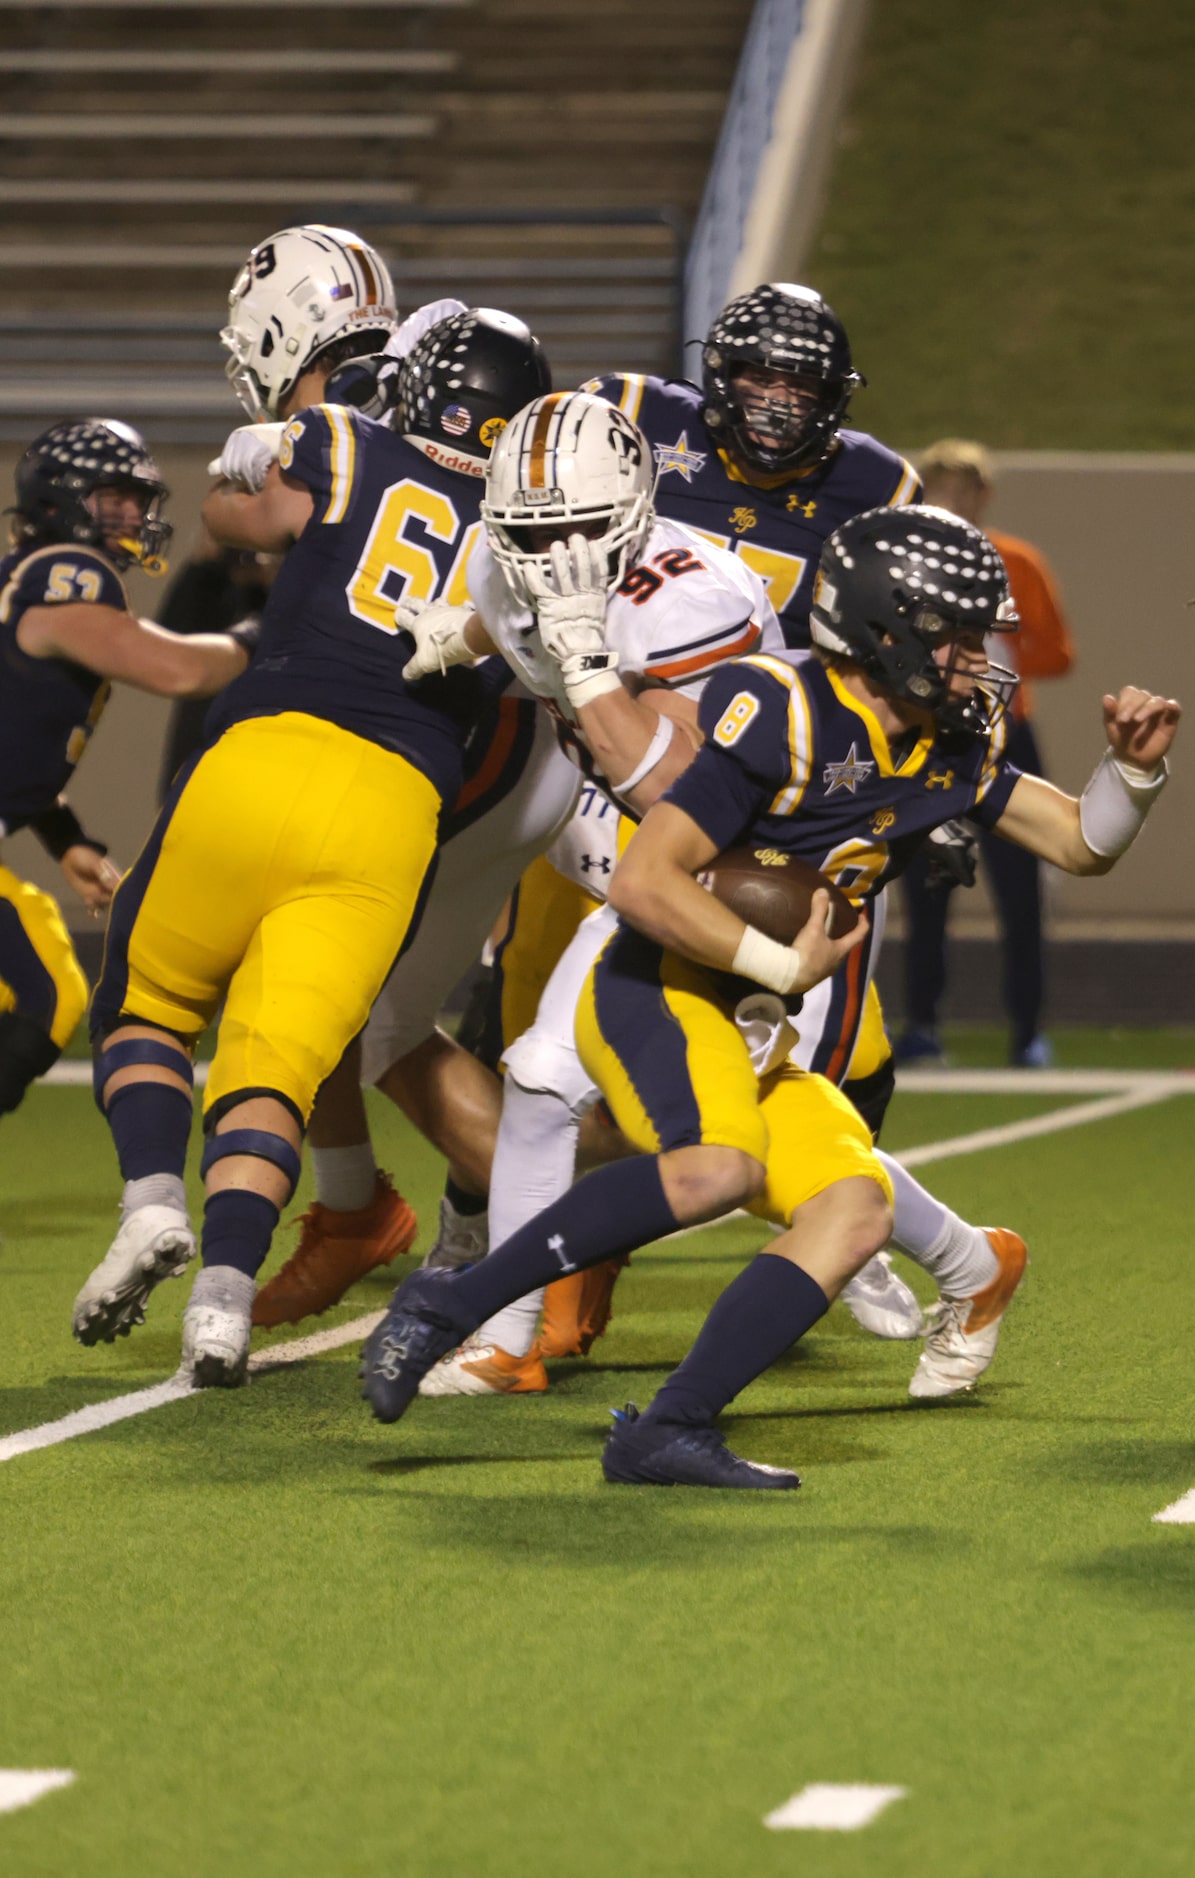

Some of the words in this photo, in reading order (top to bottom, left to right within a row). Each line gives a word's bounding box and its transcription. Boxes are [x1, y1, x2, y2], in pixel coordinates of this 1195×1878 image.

[424, 444, 486, 477] Ridde
[617, 548, 708, 606] 92
[713, 691, 761, 748] 8
